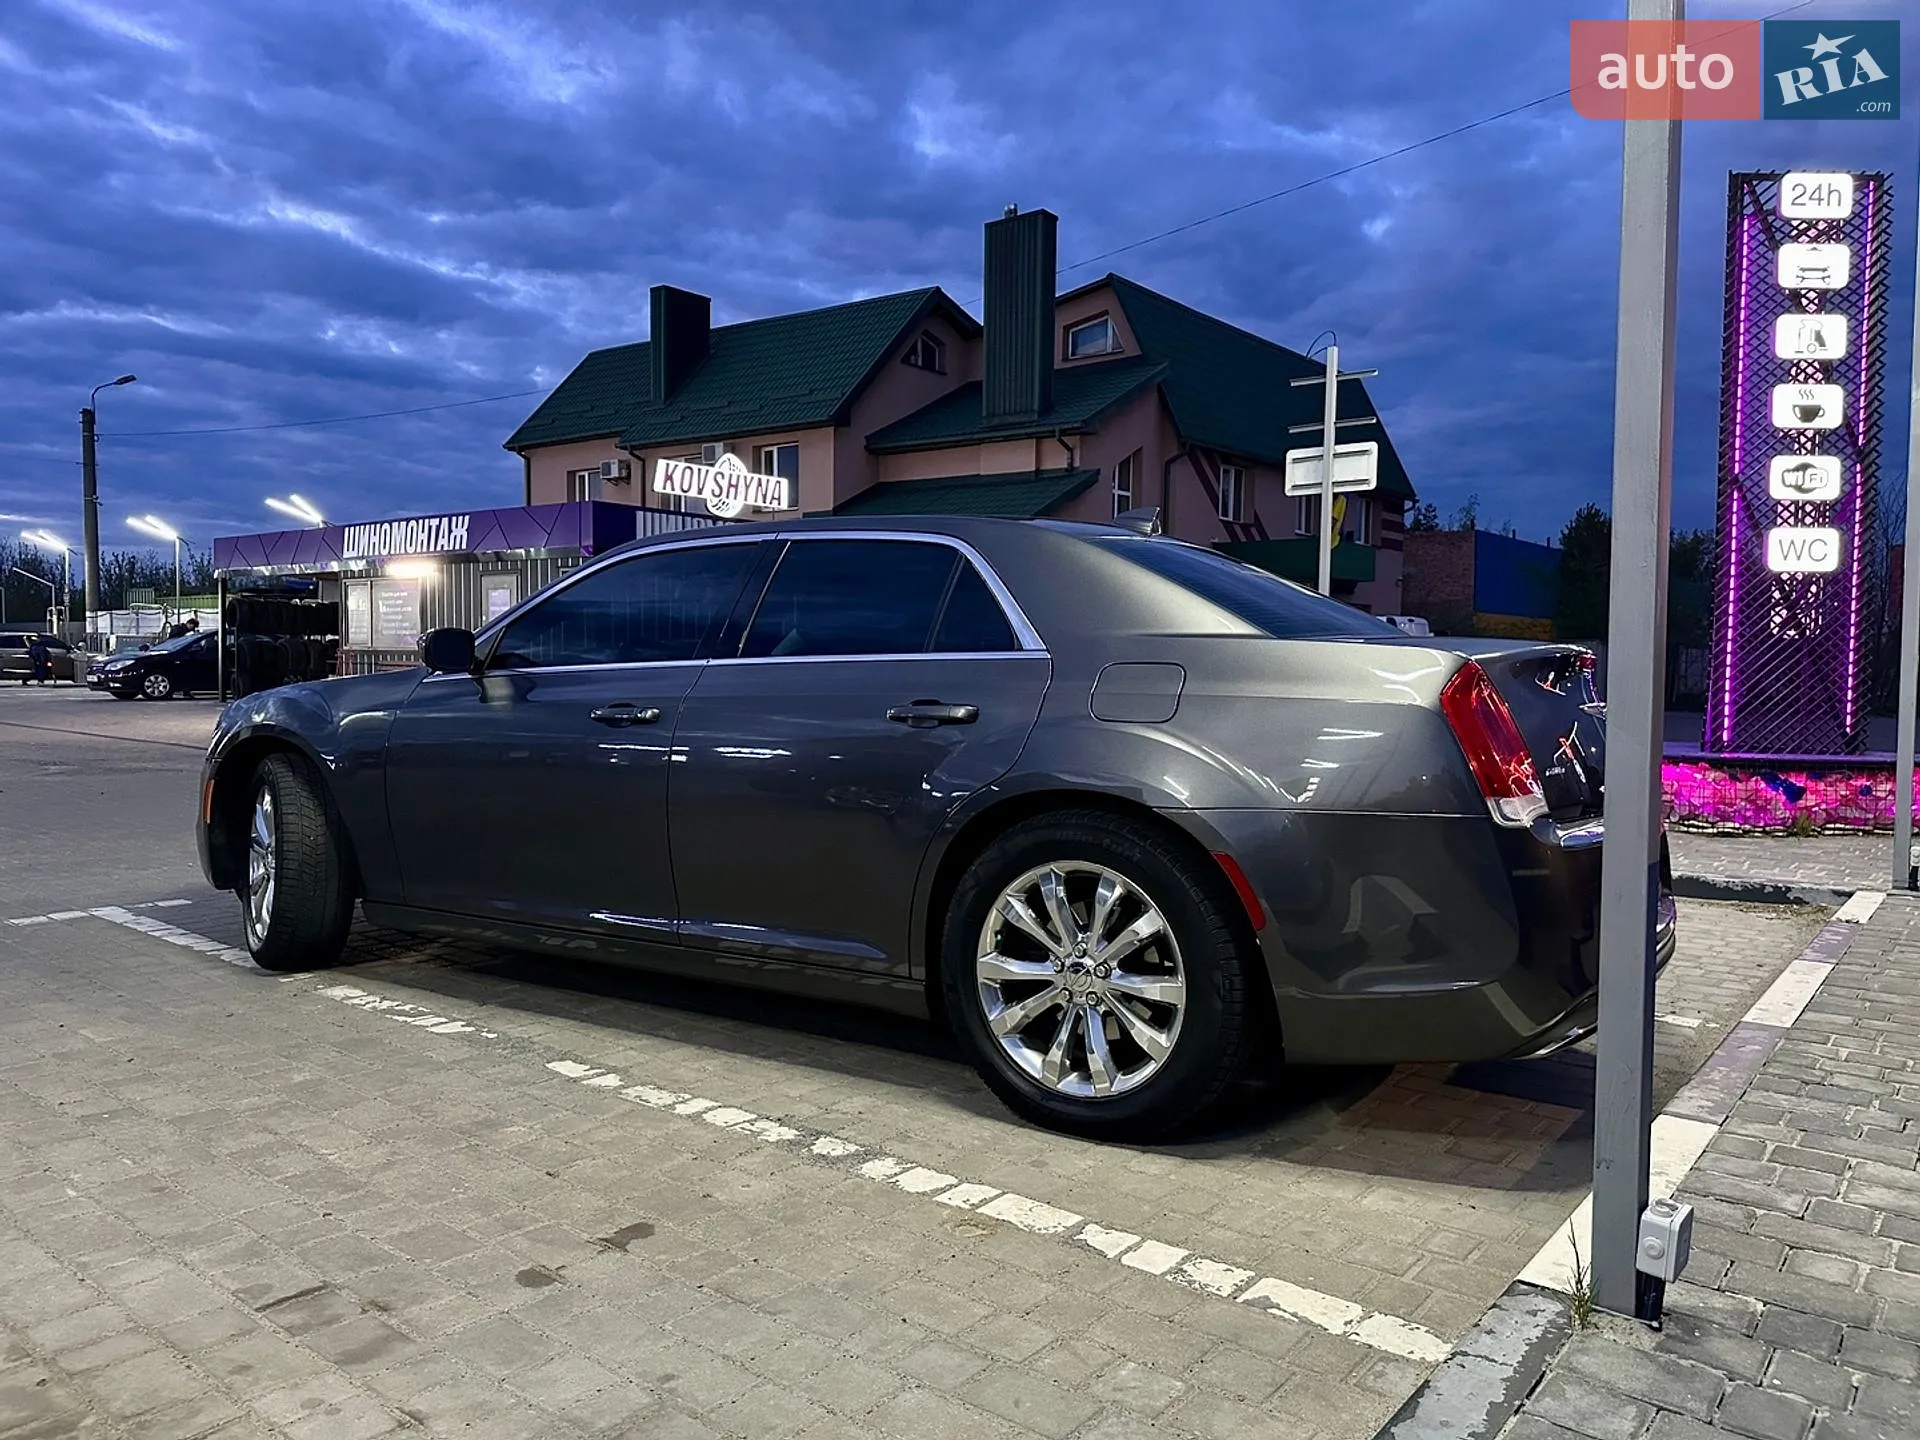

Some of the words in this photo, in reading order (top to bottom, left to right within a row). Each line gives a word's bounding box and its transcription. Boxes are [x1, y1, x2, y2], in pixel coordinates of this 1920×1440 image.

[1790, 182, 1842, 207] 24h
[662, 462, 782, 507] KOVSHYNA
[342, 515, 471, 559] ШИНОМОНТАЖ
[1778, 538, 1829, 563] WC
